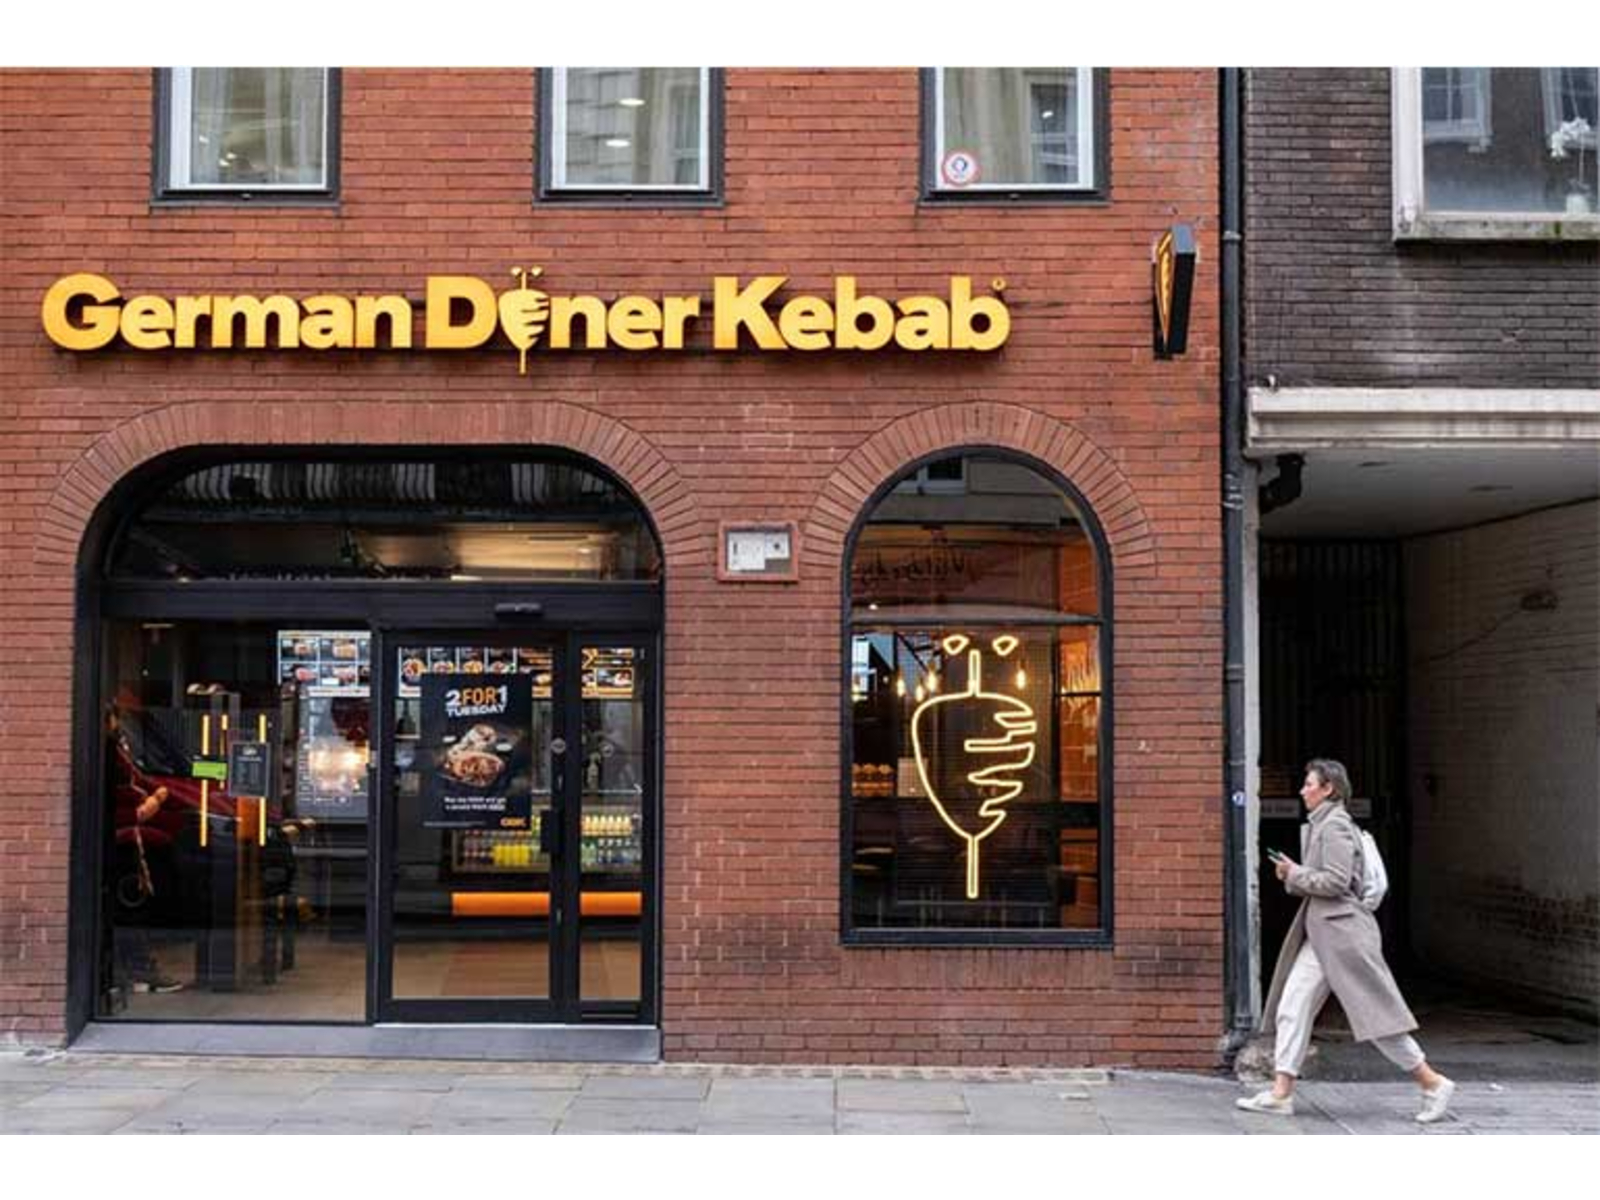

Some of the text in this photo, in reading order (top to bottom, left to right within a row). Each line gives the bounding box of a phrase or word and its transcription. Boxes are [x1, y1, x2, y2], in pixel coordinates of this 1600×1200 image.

[42, 273, 412, 350] German
[713, 275, 1011, 351] Kebab
[445, 704, 505, 717] TUESDAY
